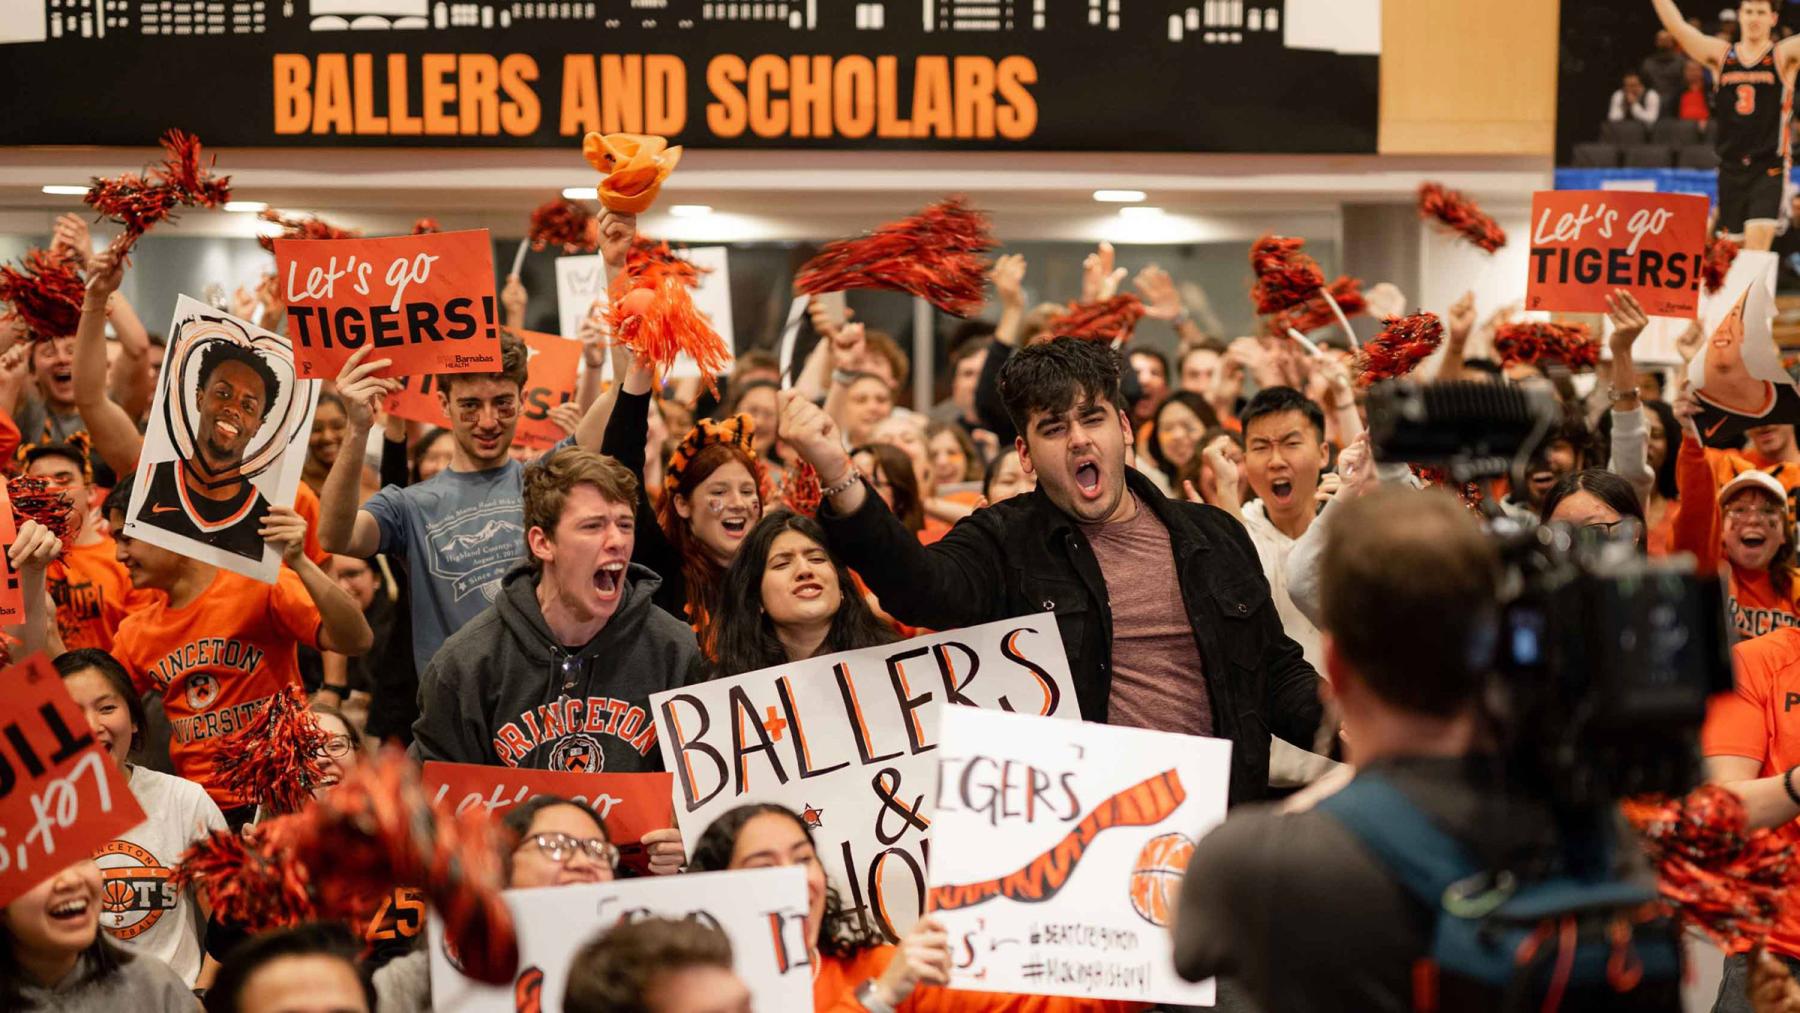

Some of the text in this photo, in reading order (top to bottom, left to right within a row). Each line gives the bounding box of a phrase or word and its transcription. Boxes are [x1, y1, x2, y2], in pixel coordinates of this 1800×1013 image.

[273, 53, 1038, 140] BALLERS AND SCHOLARS
[1735, 83, 1756, 115] 3
[1534, 203, 1673, 256] Let's go
[288, 252, 439, 312] Let's go
[1530, 247, 1702, 291] TIGERS!
[287, 295, 496, 350] TIGERS!
[148, 637, 265, 692] RINCETON
[493, 696, 658, 768] PRINCETON
[661, 628, 1062, 813] BALLERS
[871, 766, 932, 846] &
